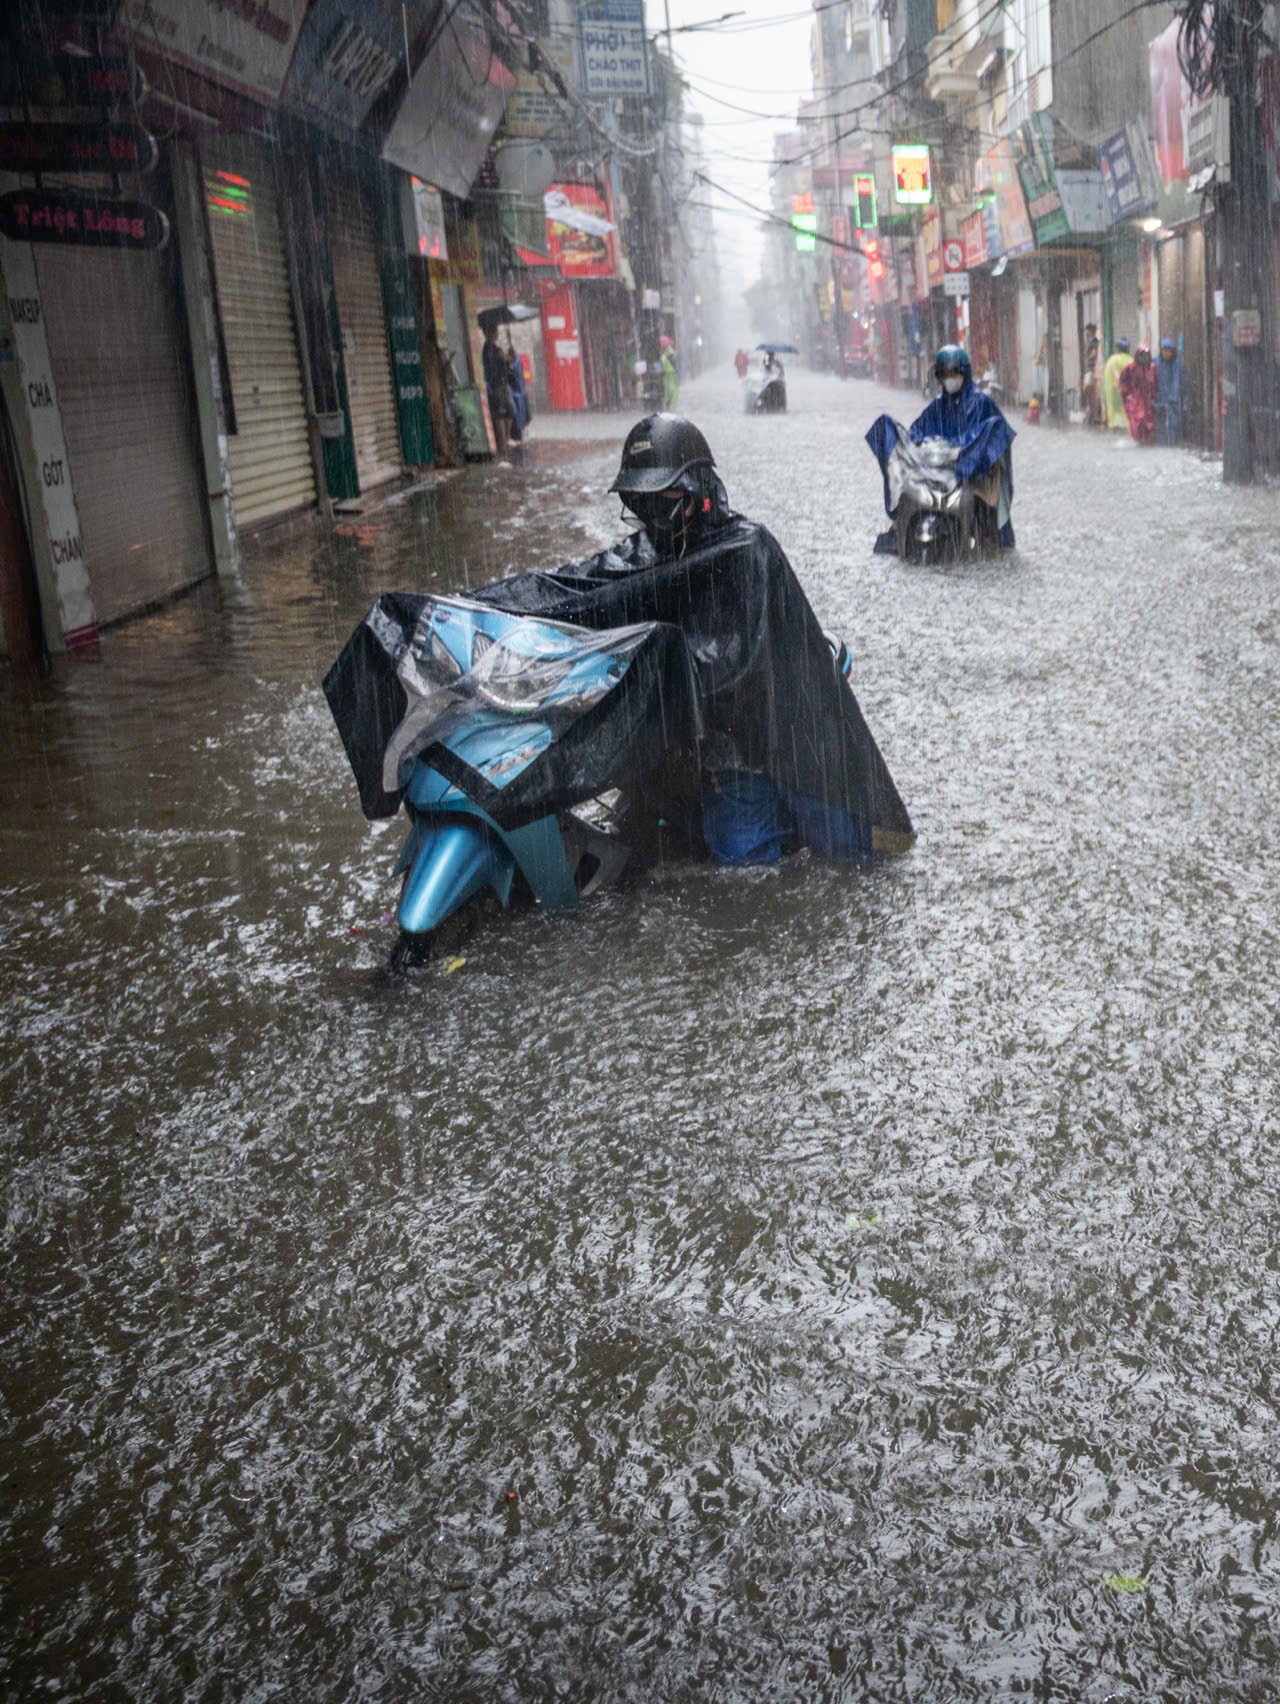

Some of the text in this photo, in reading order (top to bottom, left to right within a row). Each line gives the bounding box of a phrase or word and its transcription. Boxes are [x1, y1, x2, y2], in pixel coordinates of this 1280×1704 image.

[13, 204, 145, 239] Triệt Lông
[42, 455, 65, 488] GÓT
